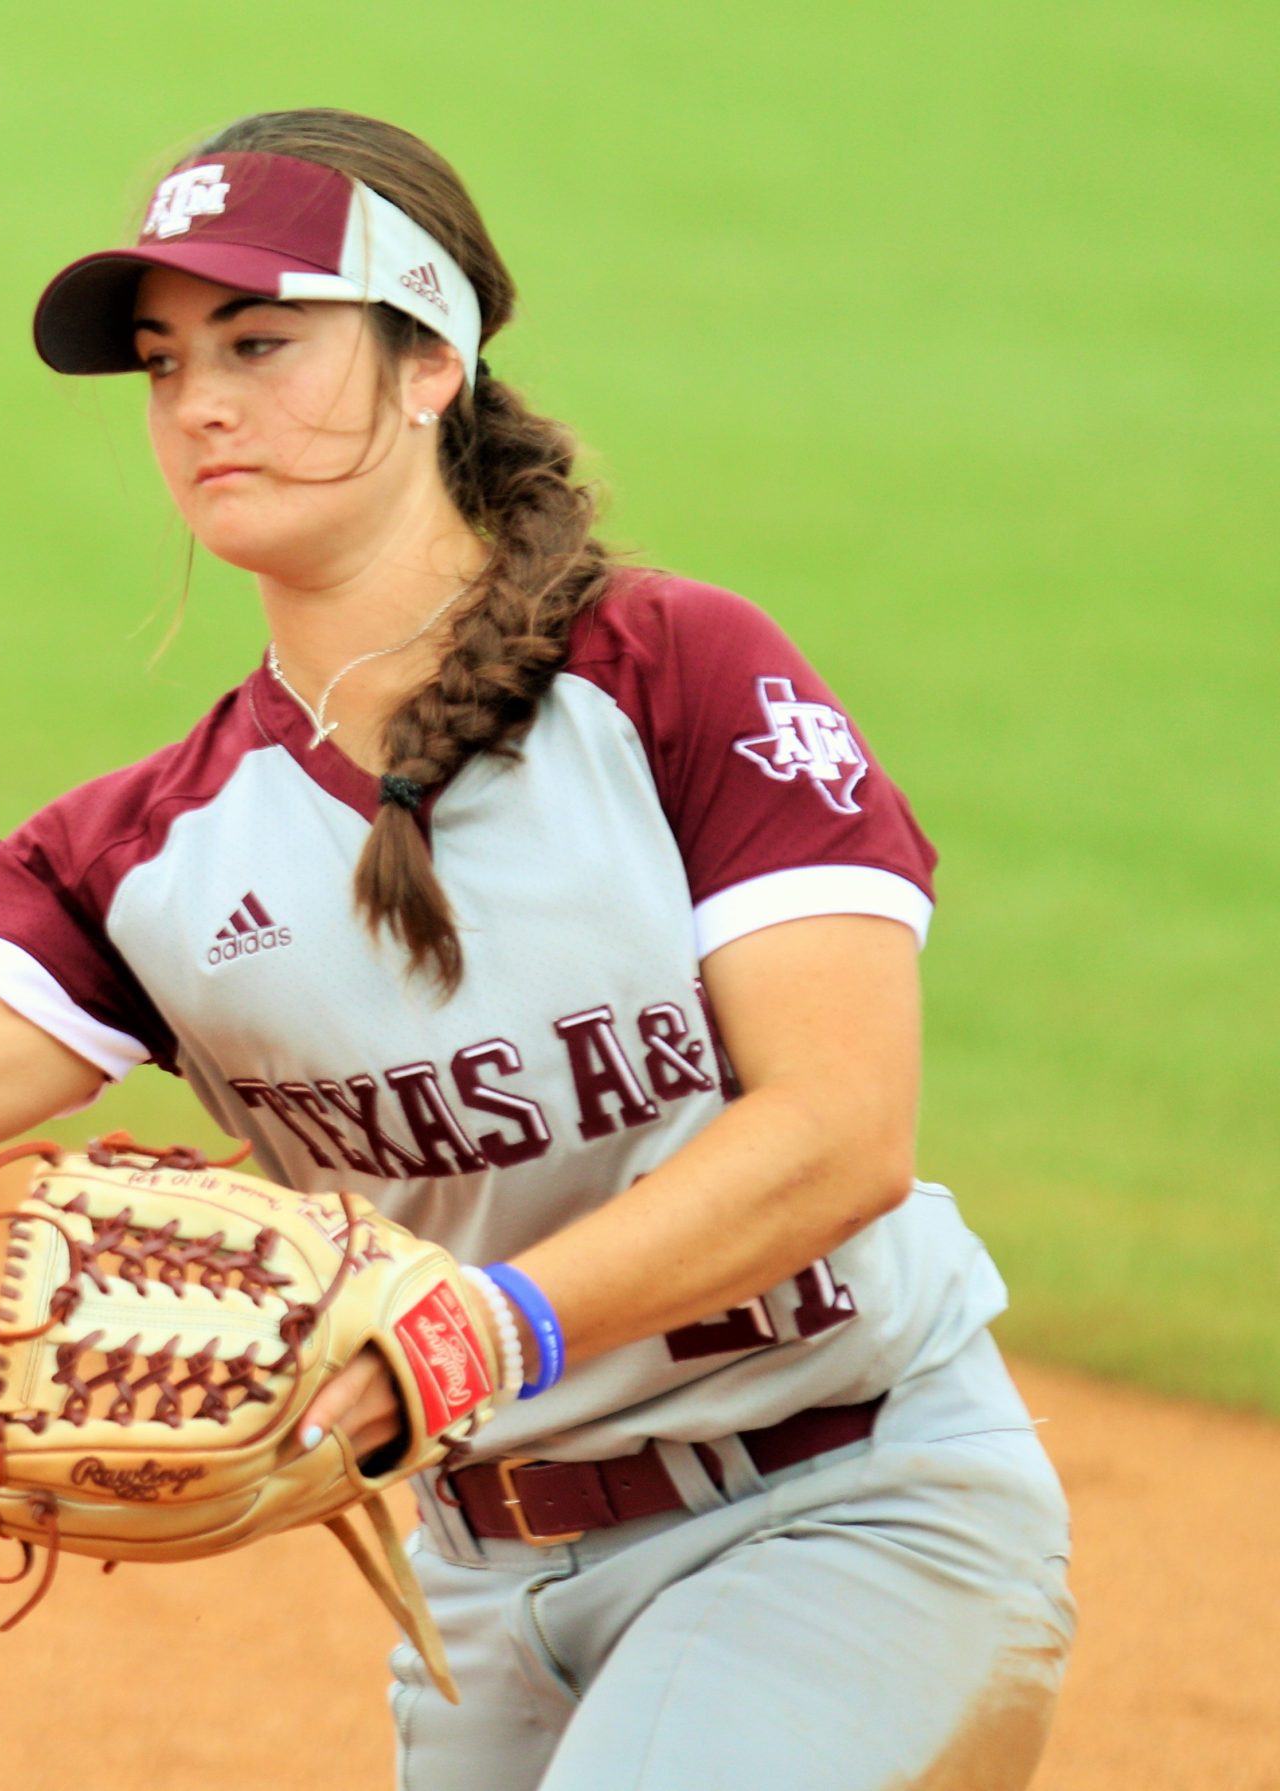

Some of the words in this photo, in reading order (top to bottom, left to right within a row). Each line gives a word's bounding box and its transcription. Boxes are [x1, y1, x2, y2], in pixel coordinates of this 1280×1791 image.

[400, 274, 449, 316] adidas
[207, 926, 292, 966] adidas
[228, 1036, 553, 1181] TEXAS
[552, 976, 745, 1142] A&
[417, 1314, 473, 1407] Rawlings
[70, 1456, 209, 1498] Rawlings
